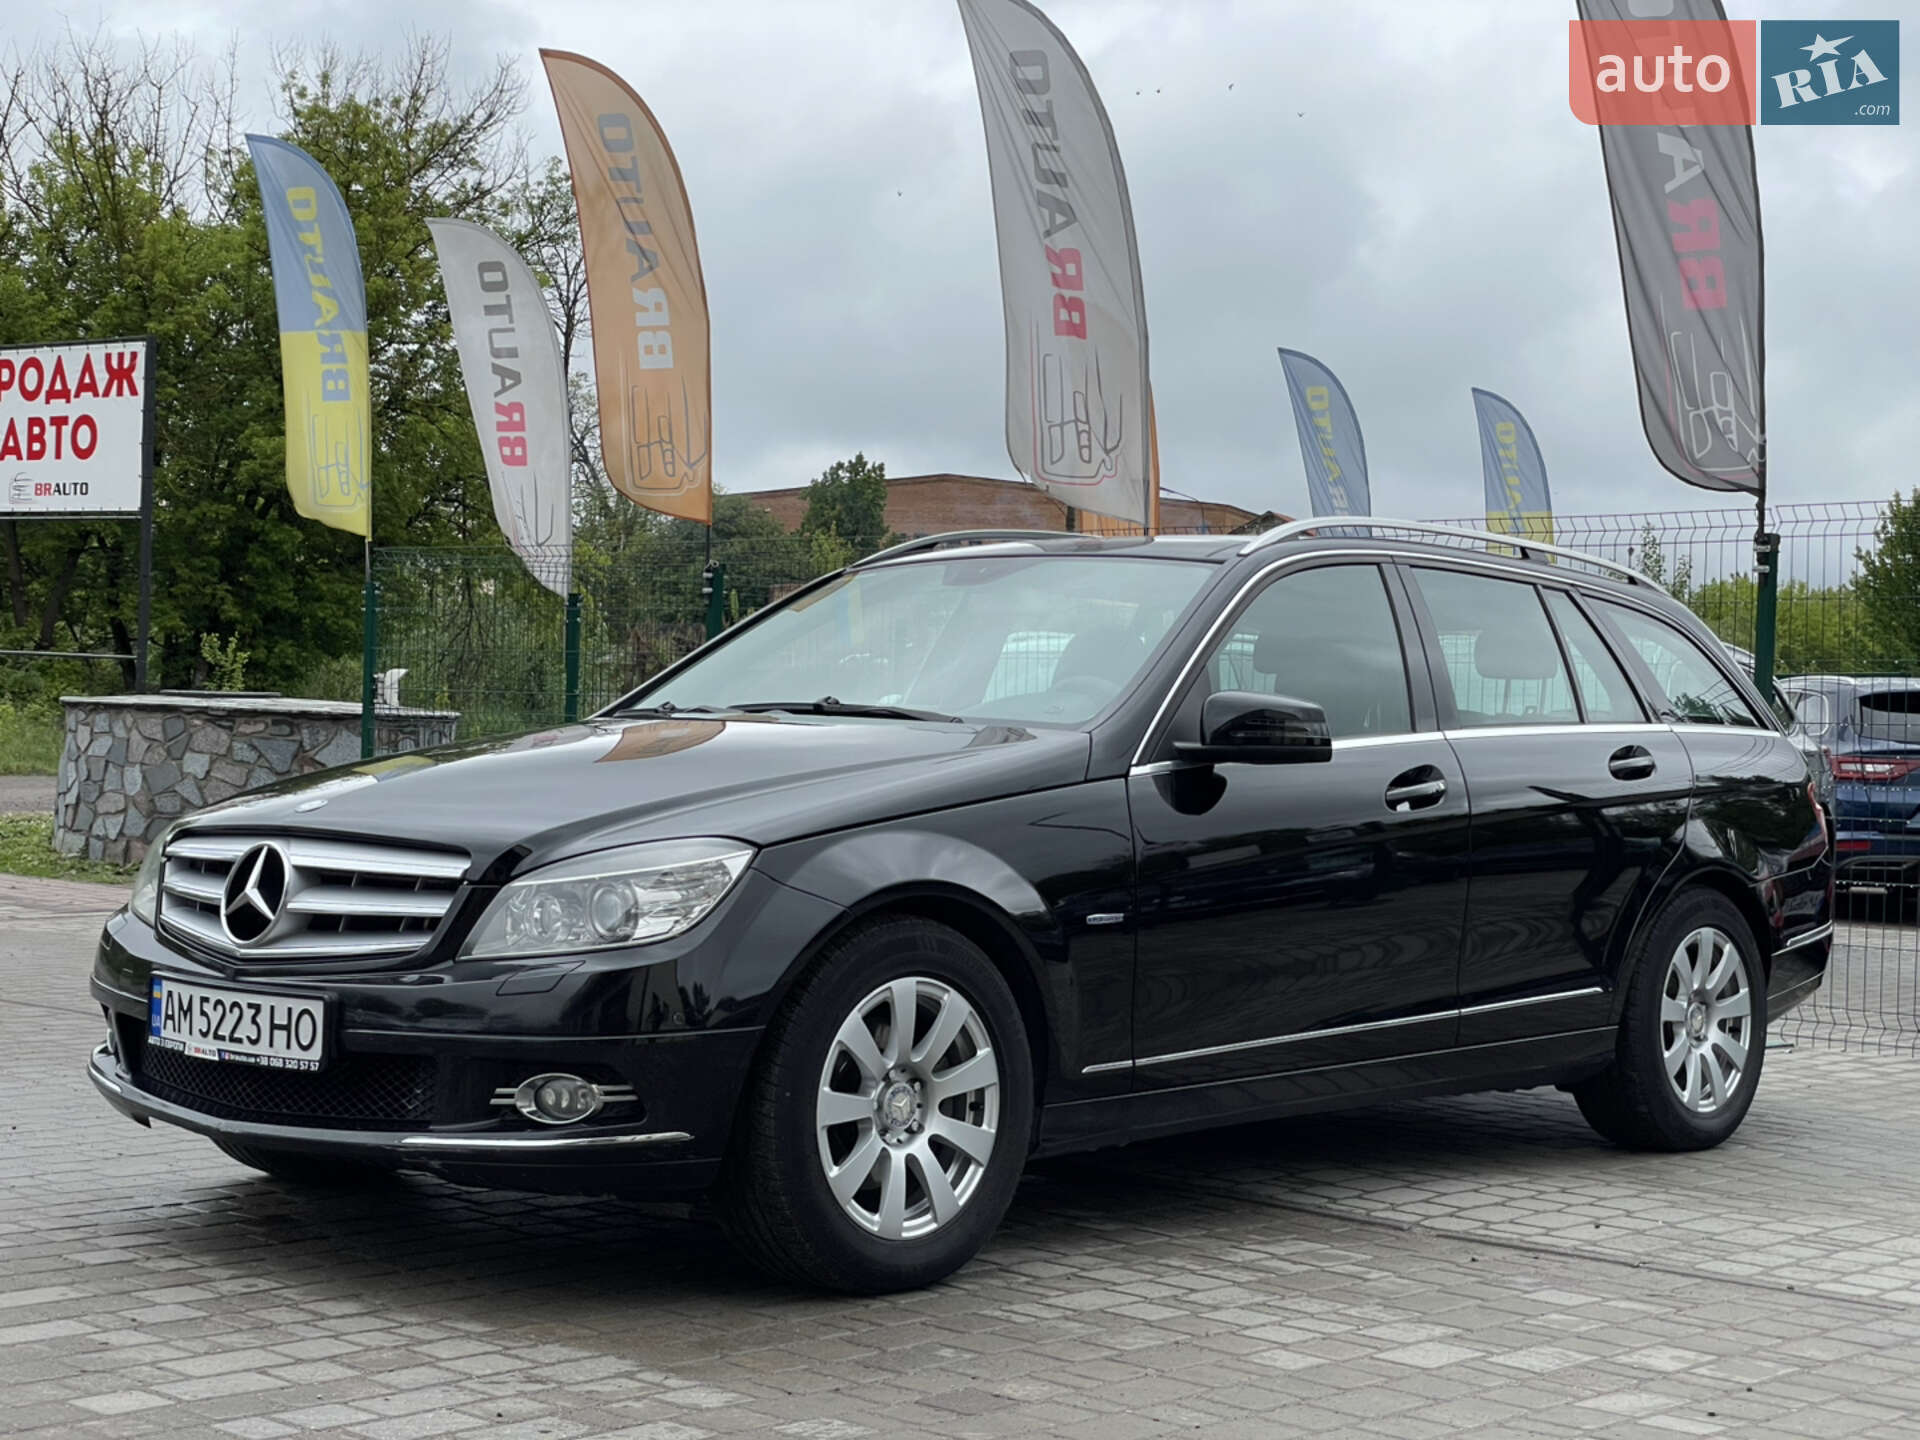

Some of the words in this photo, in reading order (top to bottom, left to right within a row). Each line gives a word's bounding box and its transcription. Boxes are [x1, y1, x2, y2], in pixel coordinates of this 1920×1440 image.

[0, 414, 98, 461] АВТО
[34, 482, 89, 496] BRAUTO
[163, 990, 193, 1036] AM
[199, 996, 262, 1045] 5223
